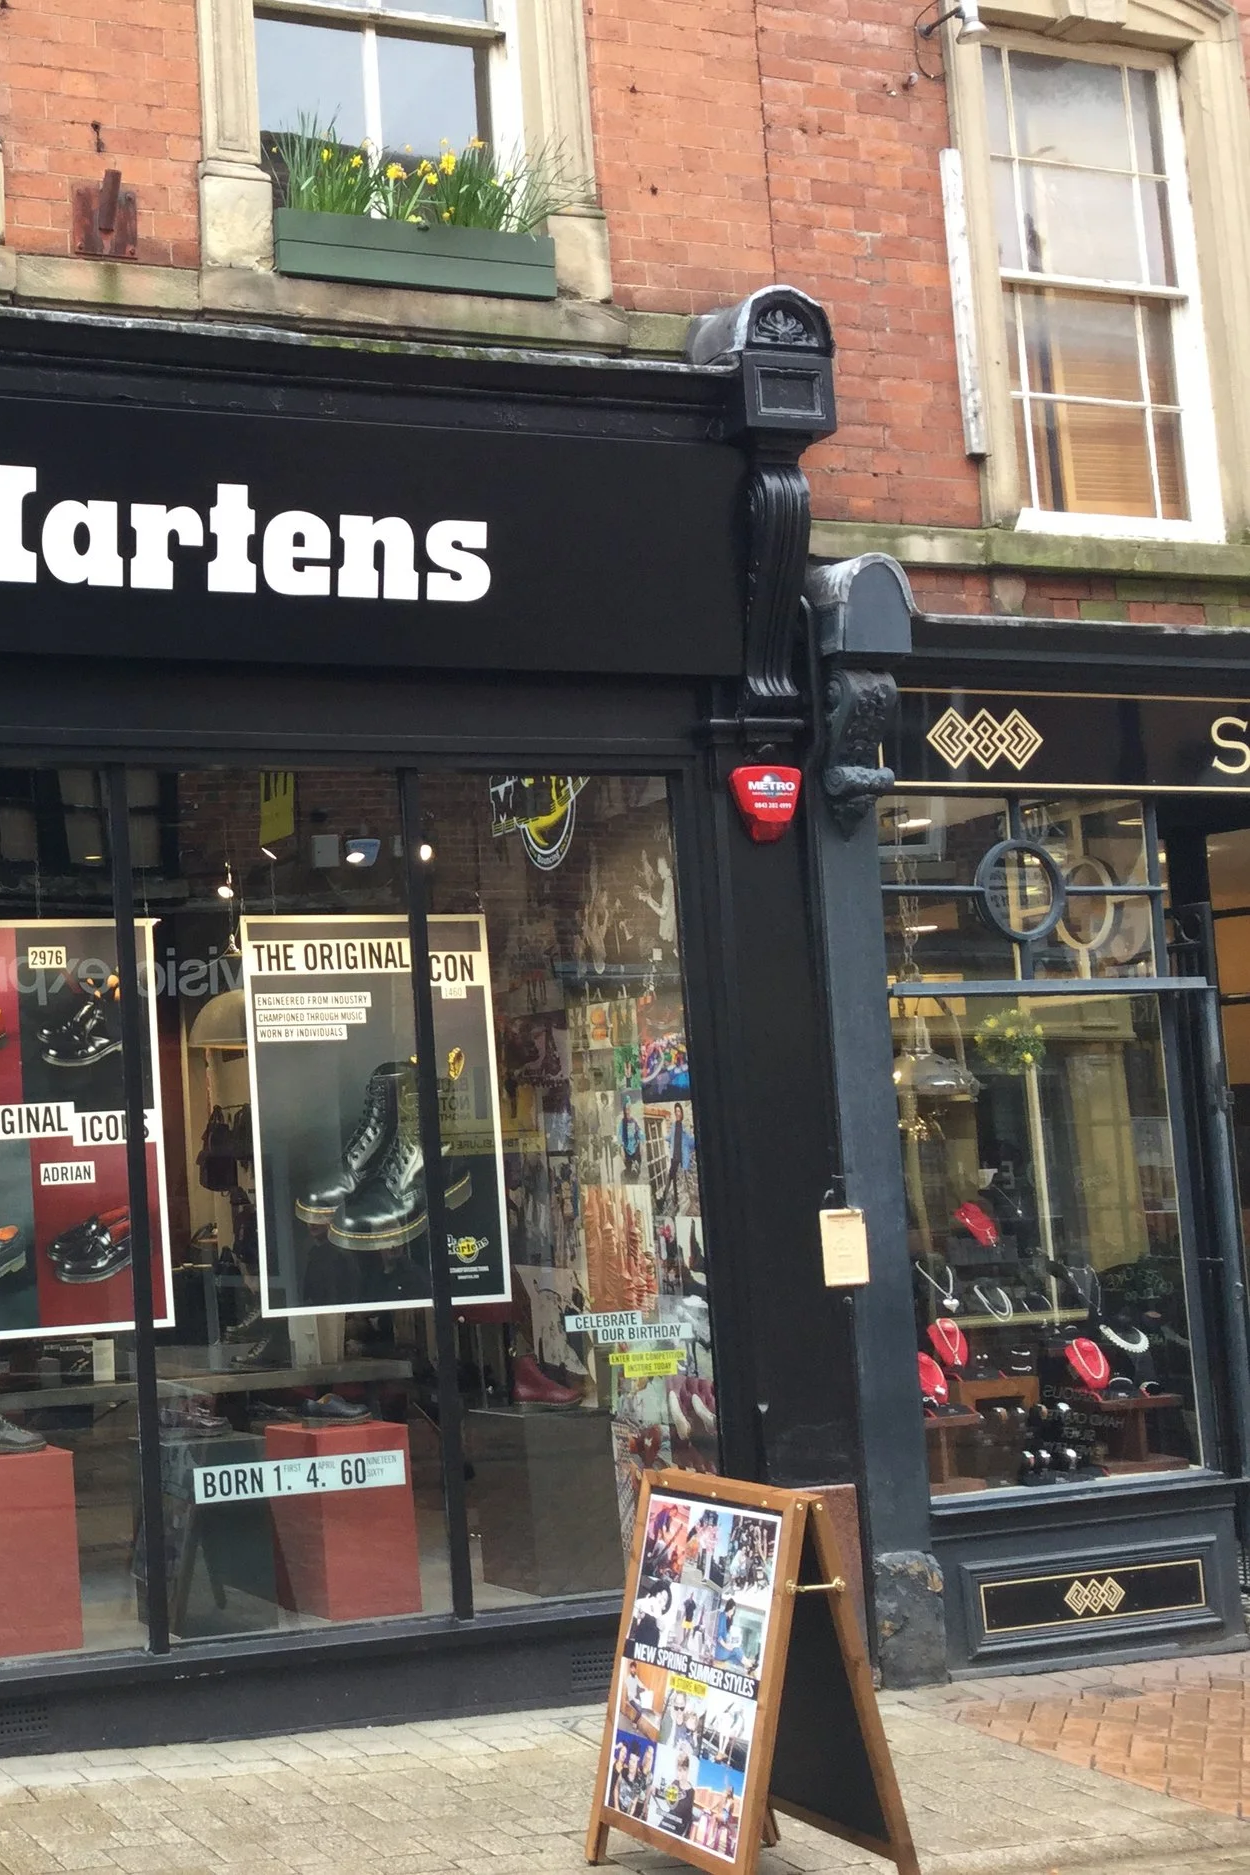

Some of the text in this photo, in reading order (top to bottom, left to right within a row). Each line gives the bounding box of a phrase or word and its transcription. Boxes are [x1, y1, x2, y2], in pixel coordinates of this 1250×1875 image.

[748, 781, 796, 791] METRO
[30, 950, 64, 966] 2976
[253, 941, 475, 982] THE ORIGINAL CON
[444, 987, 462, 997] 1460
[257, 994, 368, 1007] ENGINEERED FROM INDUSTRY
[258, 1011, 363, 1023] CHAMPIONED THROUGH MUSIC
[260, 1027, 343, 1039] WORN BY INDIVIDUALS
[43, 1164, 92, 1182] ADRIAN
[575, 1312, 637, 1329] CELEBRATE
[602, 1325, 682, 1341] OUR BIRTHDAY
[611, 1351, 686, 1363] ENTER OUR COMPETITION
[627, 1362, 671, 1372] INSTORE TODAY
[317, 1460, 336, 1470] APRIL
[366, 1455, 397, 1466] NINETEEN
[283, 1463, 302, 1473] FIRST
[366, 1468, 384, 1477] SIXTY
[202, 1467, 264, 1499] BORN
[340, 1458, 367, 1486] 60
[634, 1642, 755, 1698] NEW SPRING SUMMER STYLES
